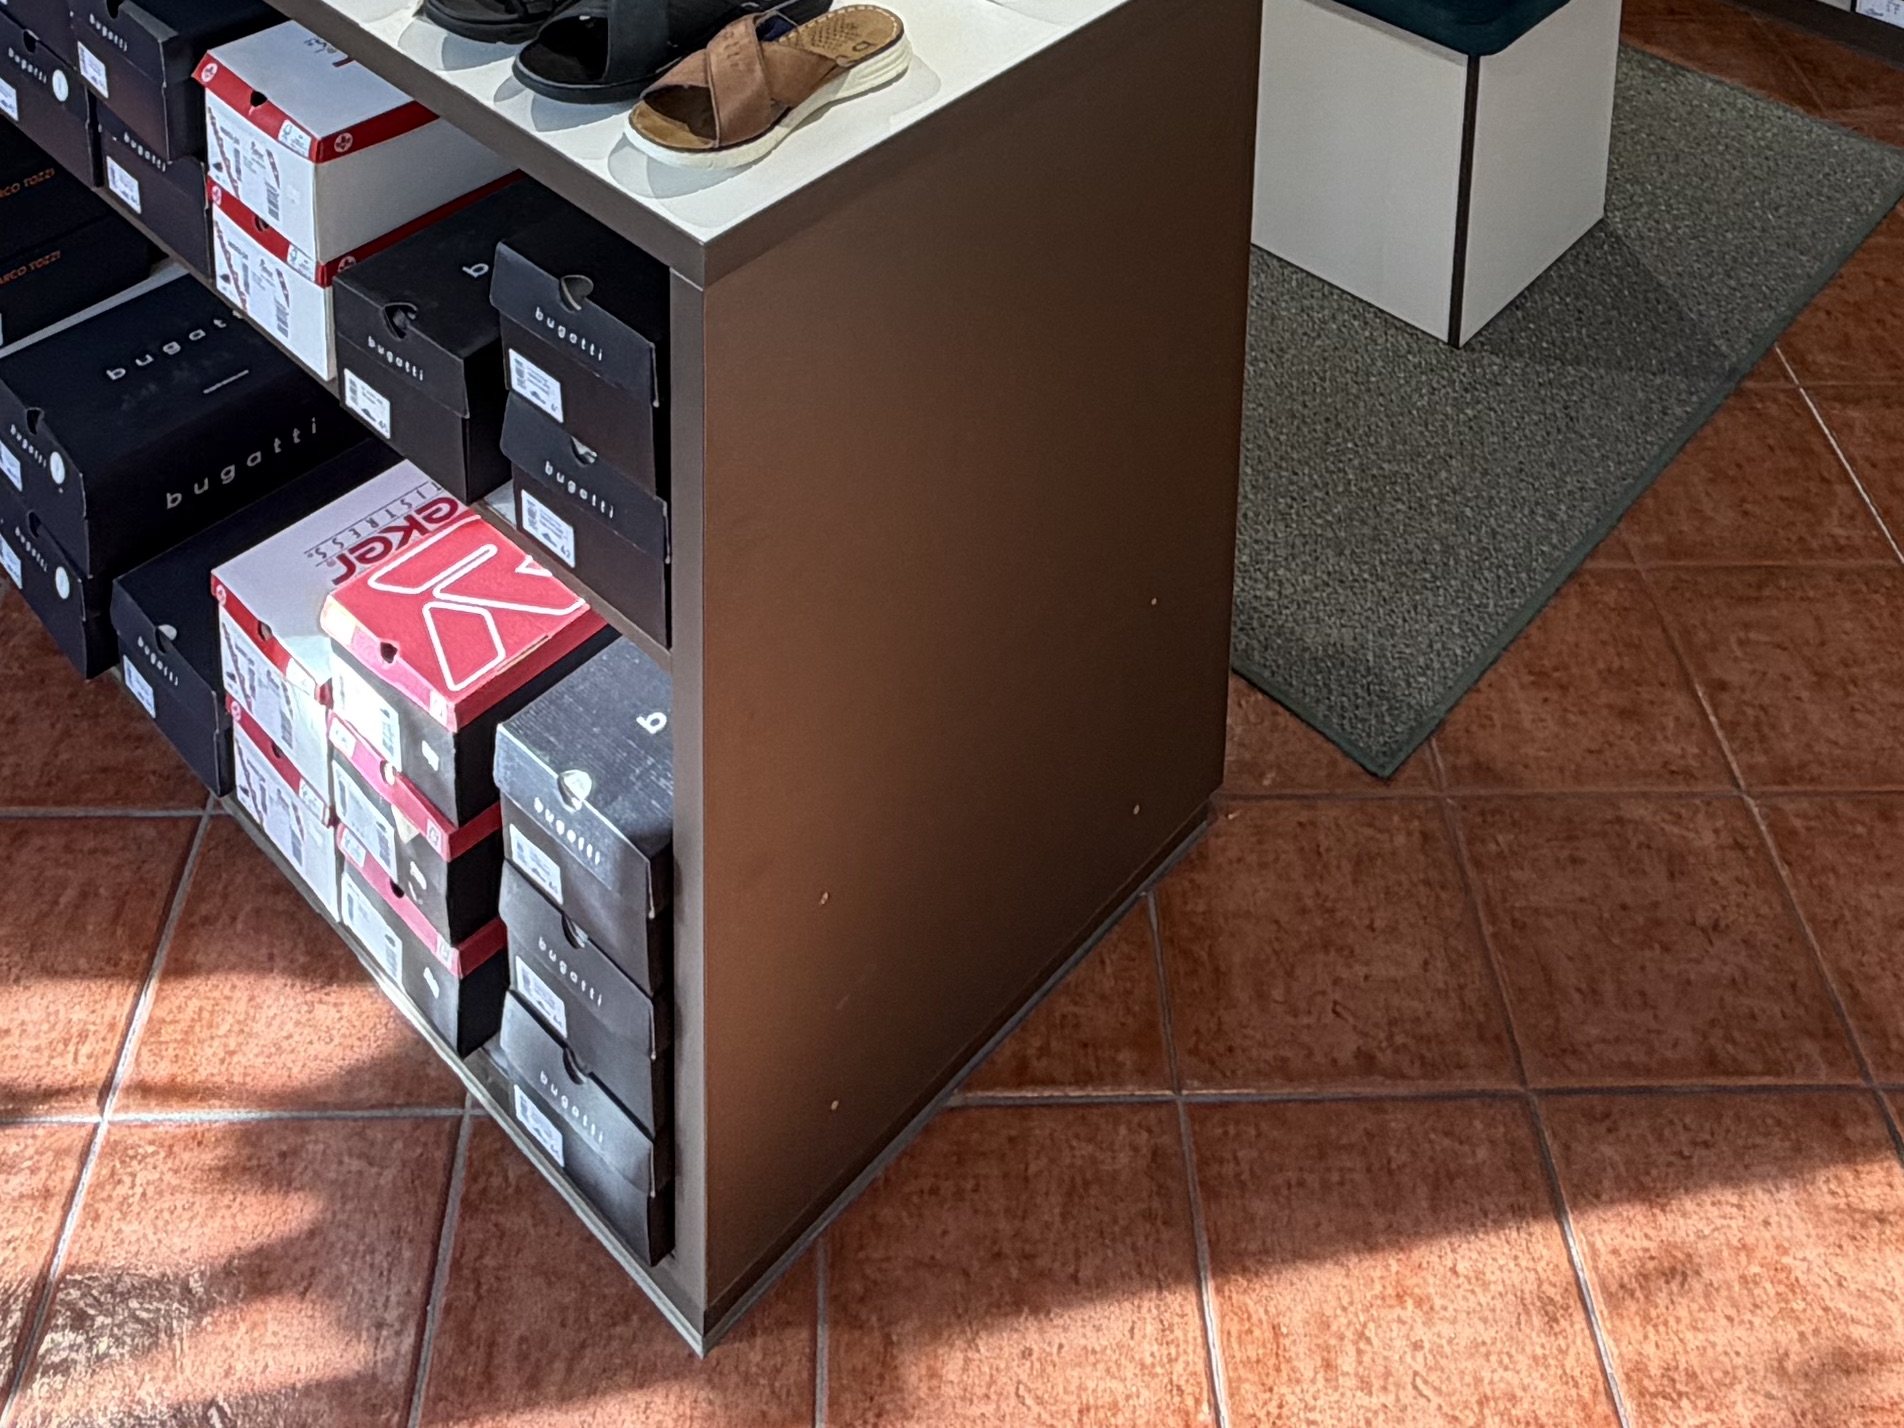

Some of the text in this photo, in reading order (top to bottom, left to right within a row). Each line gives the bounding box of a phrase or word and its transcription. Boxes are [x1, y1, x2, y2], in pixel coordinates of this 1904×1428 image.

[24, 168, 55, 188] TOZZI
[29, 250, 61, 270] TOZZI
[106, 310, 245, 380] bugat
[368, 336, 424, 381] bugatti
[535, 307, 603, 361] bugatti
[166, 417, 317, 509] bugatti
[545, 461, 614, 519] bugatti
[331, 497, 459, 585] eker
[533, 796, 601, 866] bugatti
[538, 936, 602, 1008] bugatti
[539, 1070, 605, 1145] bugatti
